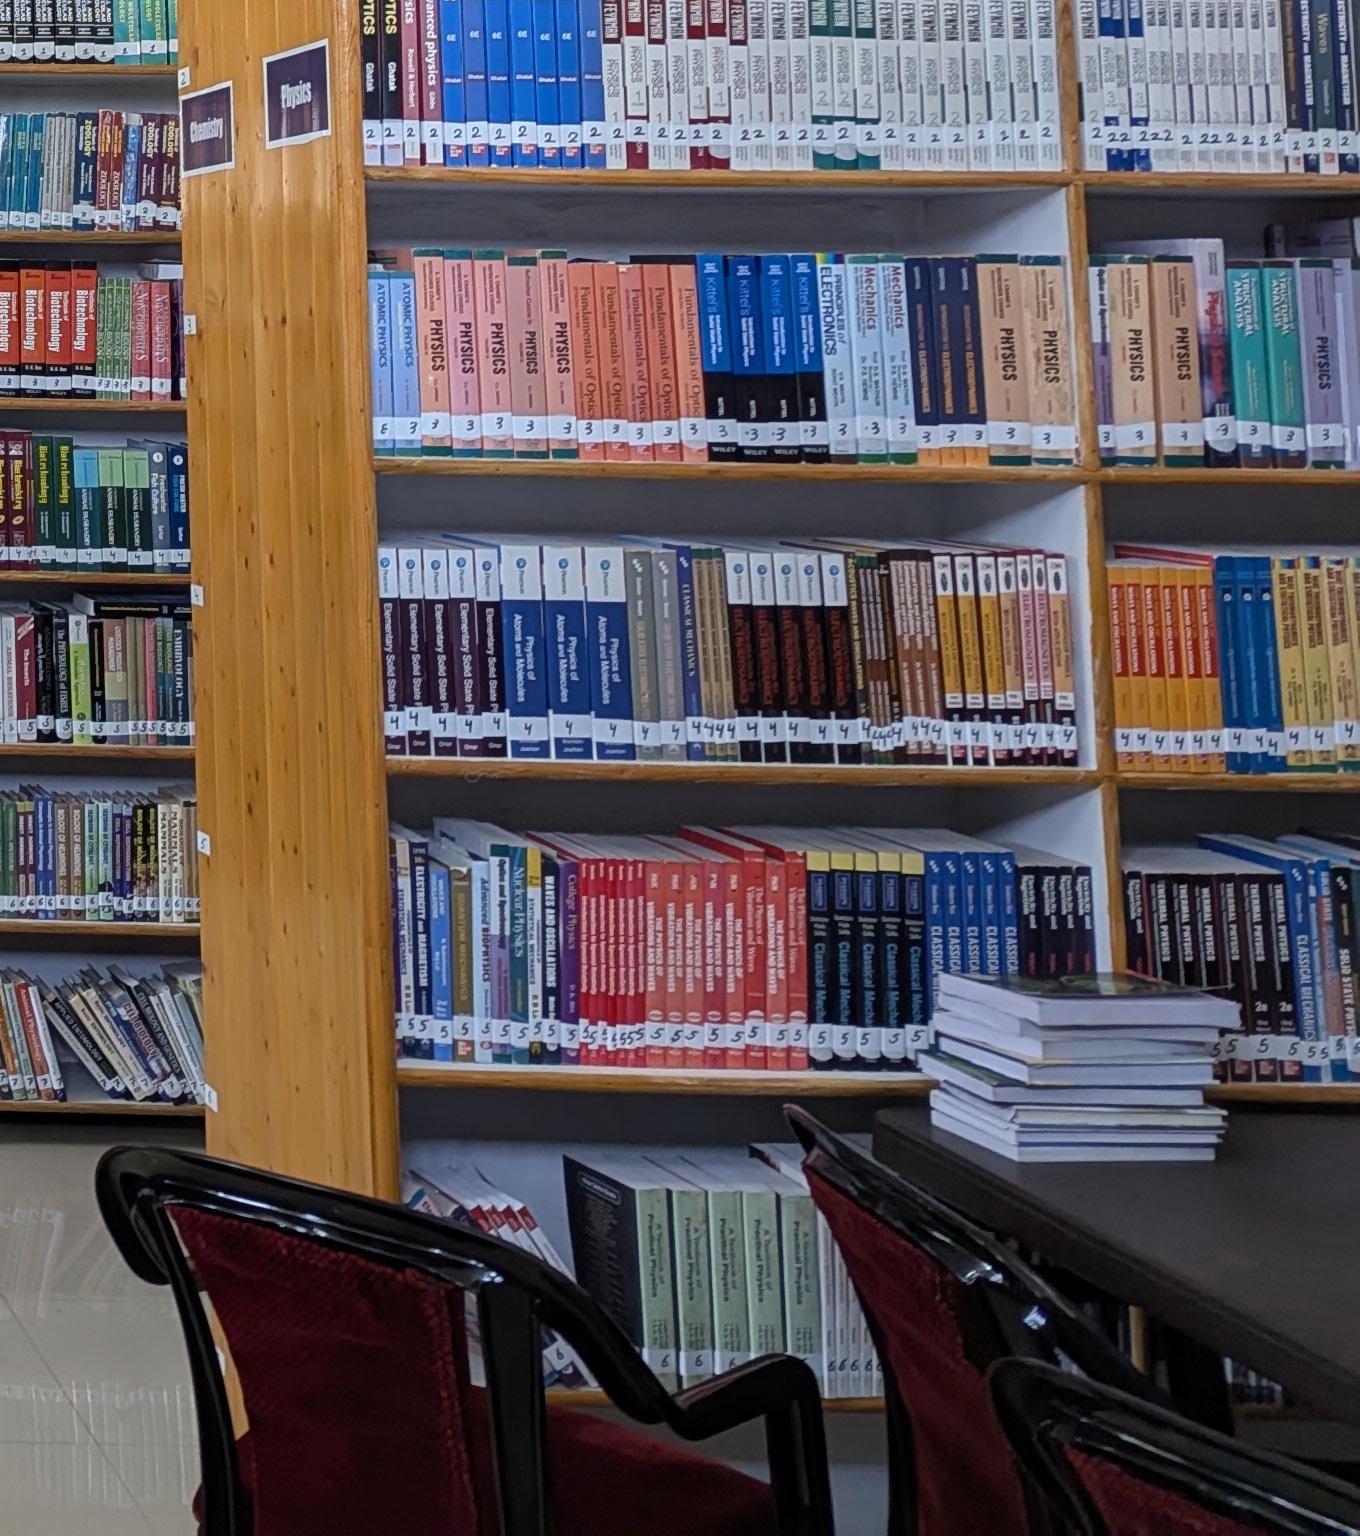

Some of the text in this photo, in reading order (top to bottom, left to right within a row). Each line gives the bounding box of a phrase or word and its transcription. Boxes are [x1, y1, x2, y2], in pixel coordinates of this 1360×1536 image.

[180, 72, 186, 85] 2
[425, 41, 436, 86] physics
[281, 80, 311, 109] Physics
[83, 119, 92, 158] ZOOLOGY
[147, 121, 155, 159] ZOOLOGY
[190, 118, 223, 143] Chemistry
[366, 129, 375, 139] 2
[407, 127, 415, 137] 2
[820, 266, 837, 356] ELECTRONICS
[864, 266, 877, 331] Mechanics
[891, 266, 904, 329] Mechanics
[24, 289, 37, 351] Biotechnology
[74, 289, 88, 351] Biotechnology
[376, 282, 387, 368] ATOMIC PHYSICS
[402, 282, 414, 368] ATOMIC PHYSICS
[580, 286, 595, 378] Fundamentals of
[430, 319, 445, 372] PHYSICS
[459, 322, 474, 375] PHYSICS
[555, 322, 570, 374] PHYSICS
[999, 327, 1018, 382] PHYSICS
[431, 419, 439, 430] 3
[496, 417, 504, 429] 3
[386, 654, 395, 678] Solid
[391, 716, 399, 730] 4
[525, 724, 532, 735] 4
[499, 1024, 511, 1037] 5
[1257, 1038, 1269, 1053] 5
